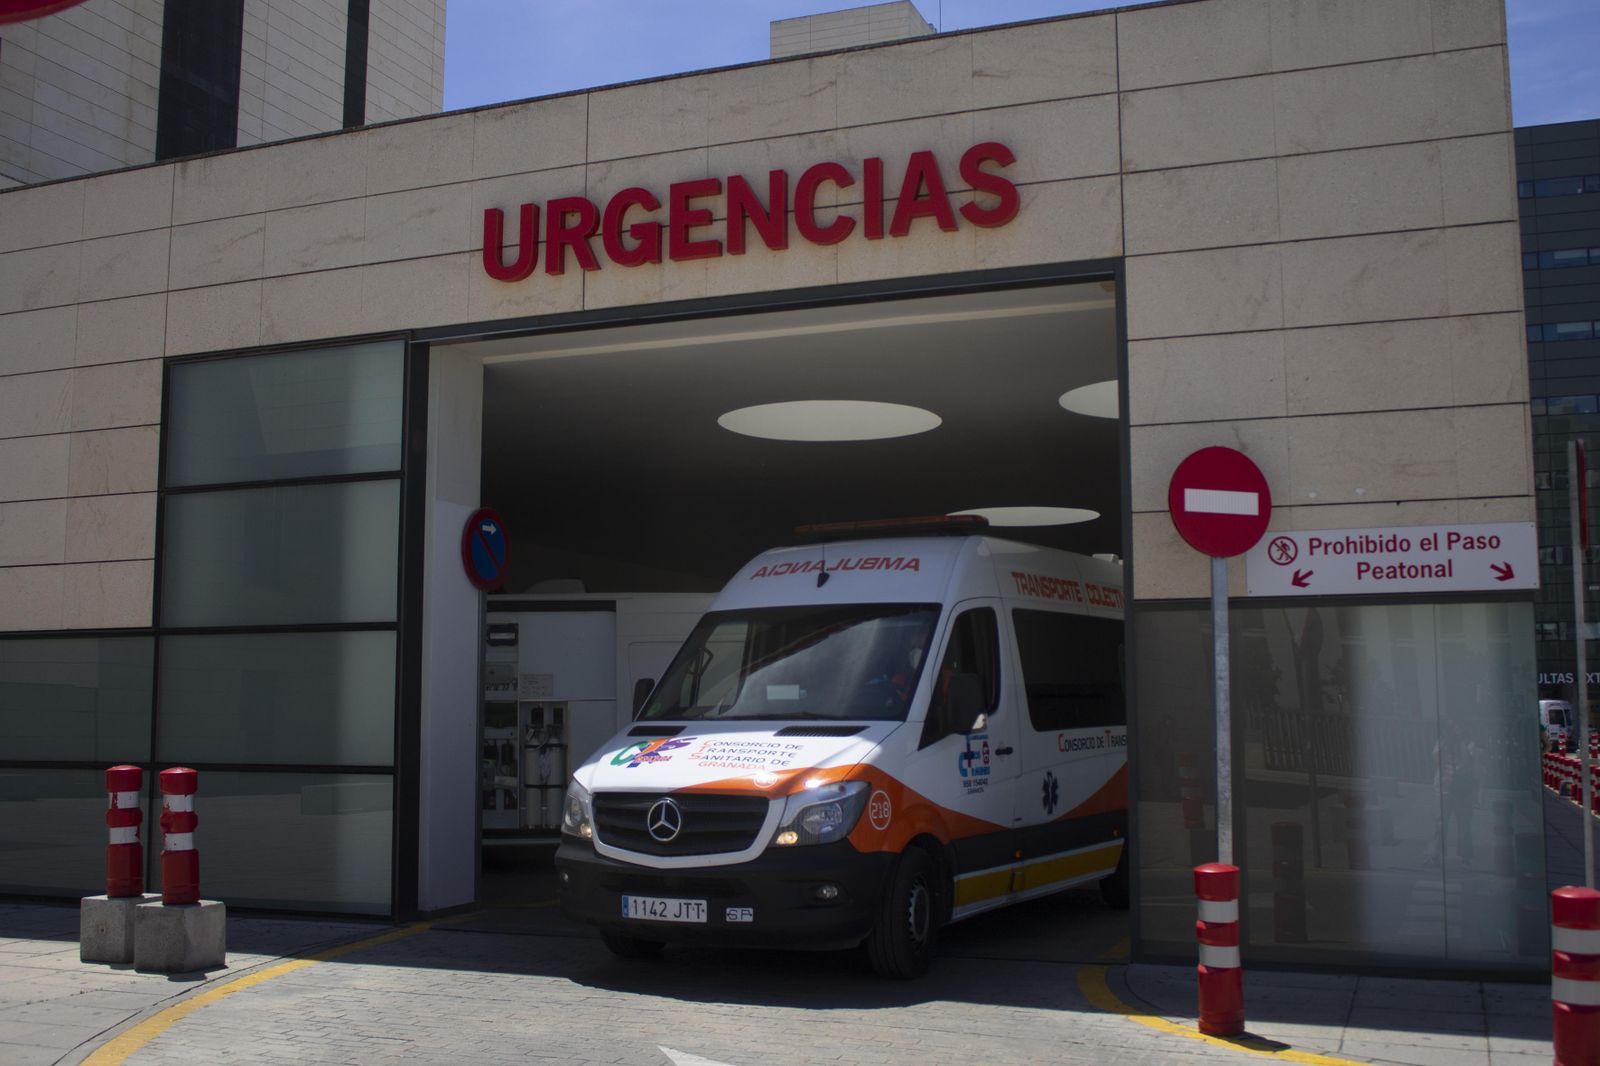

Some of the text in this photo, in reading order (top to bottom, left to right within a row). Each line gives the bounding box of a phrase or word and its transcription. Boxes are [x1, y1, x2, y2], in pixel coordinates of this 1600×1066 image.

[483, 142, 1019, 281] URGENCIAS
[1309, 531, 1500, 556] Prohibido el Paso
[1357, 559, 1452, 580] Peatonal
[1012, 572, 1083, 602] TRANSPORTE
[704, 740, 780, 749] CONSORCIO
[1058, 733, 1095, 752] CONSORCIO
[1097, 736, 1104, 749] DE
[688, 752, 790, 767] SANITARIO DE
[699, 746, 798, 758] TRANSPORTE
[698, 761, 765, 770] GRANADA
[871, 802, 889, 819] 218
[634, 899, 667, 918] 1142
[673, 902, 703, 919] JTT
[728, 909, 751, 921] SP
